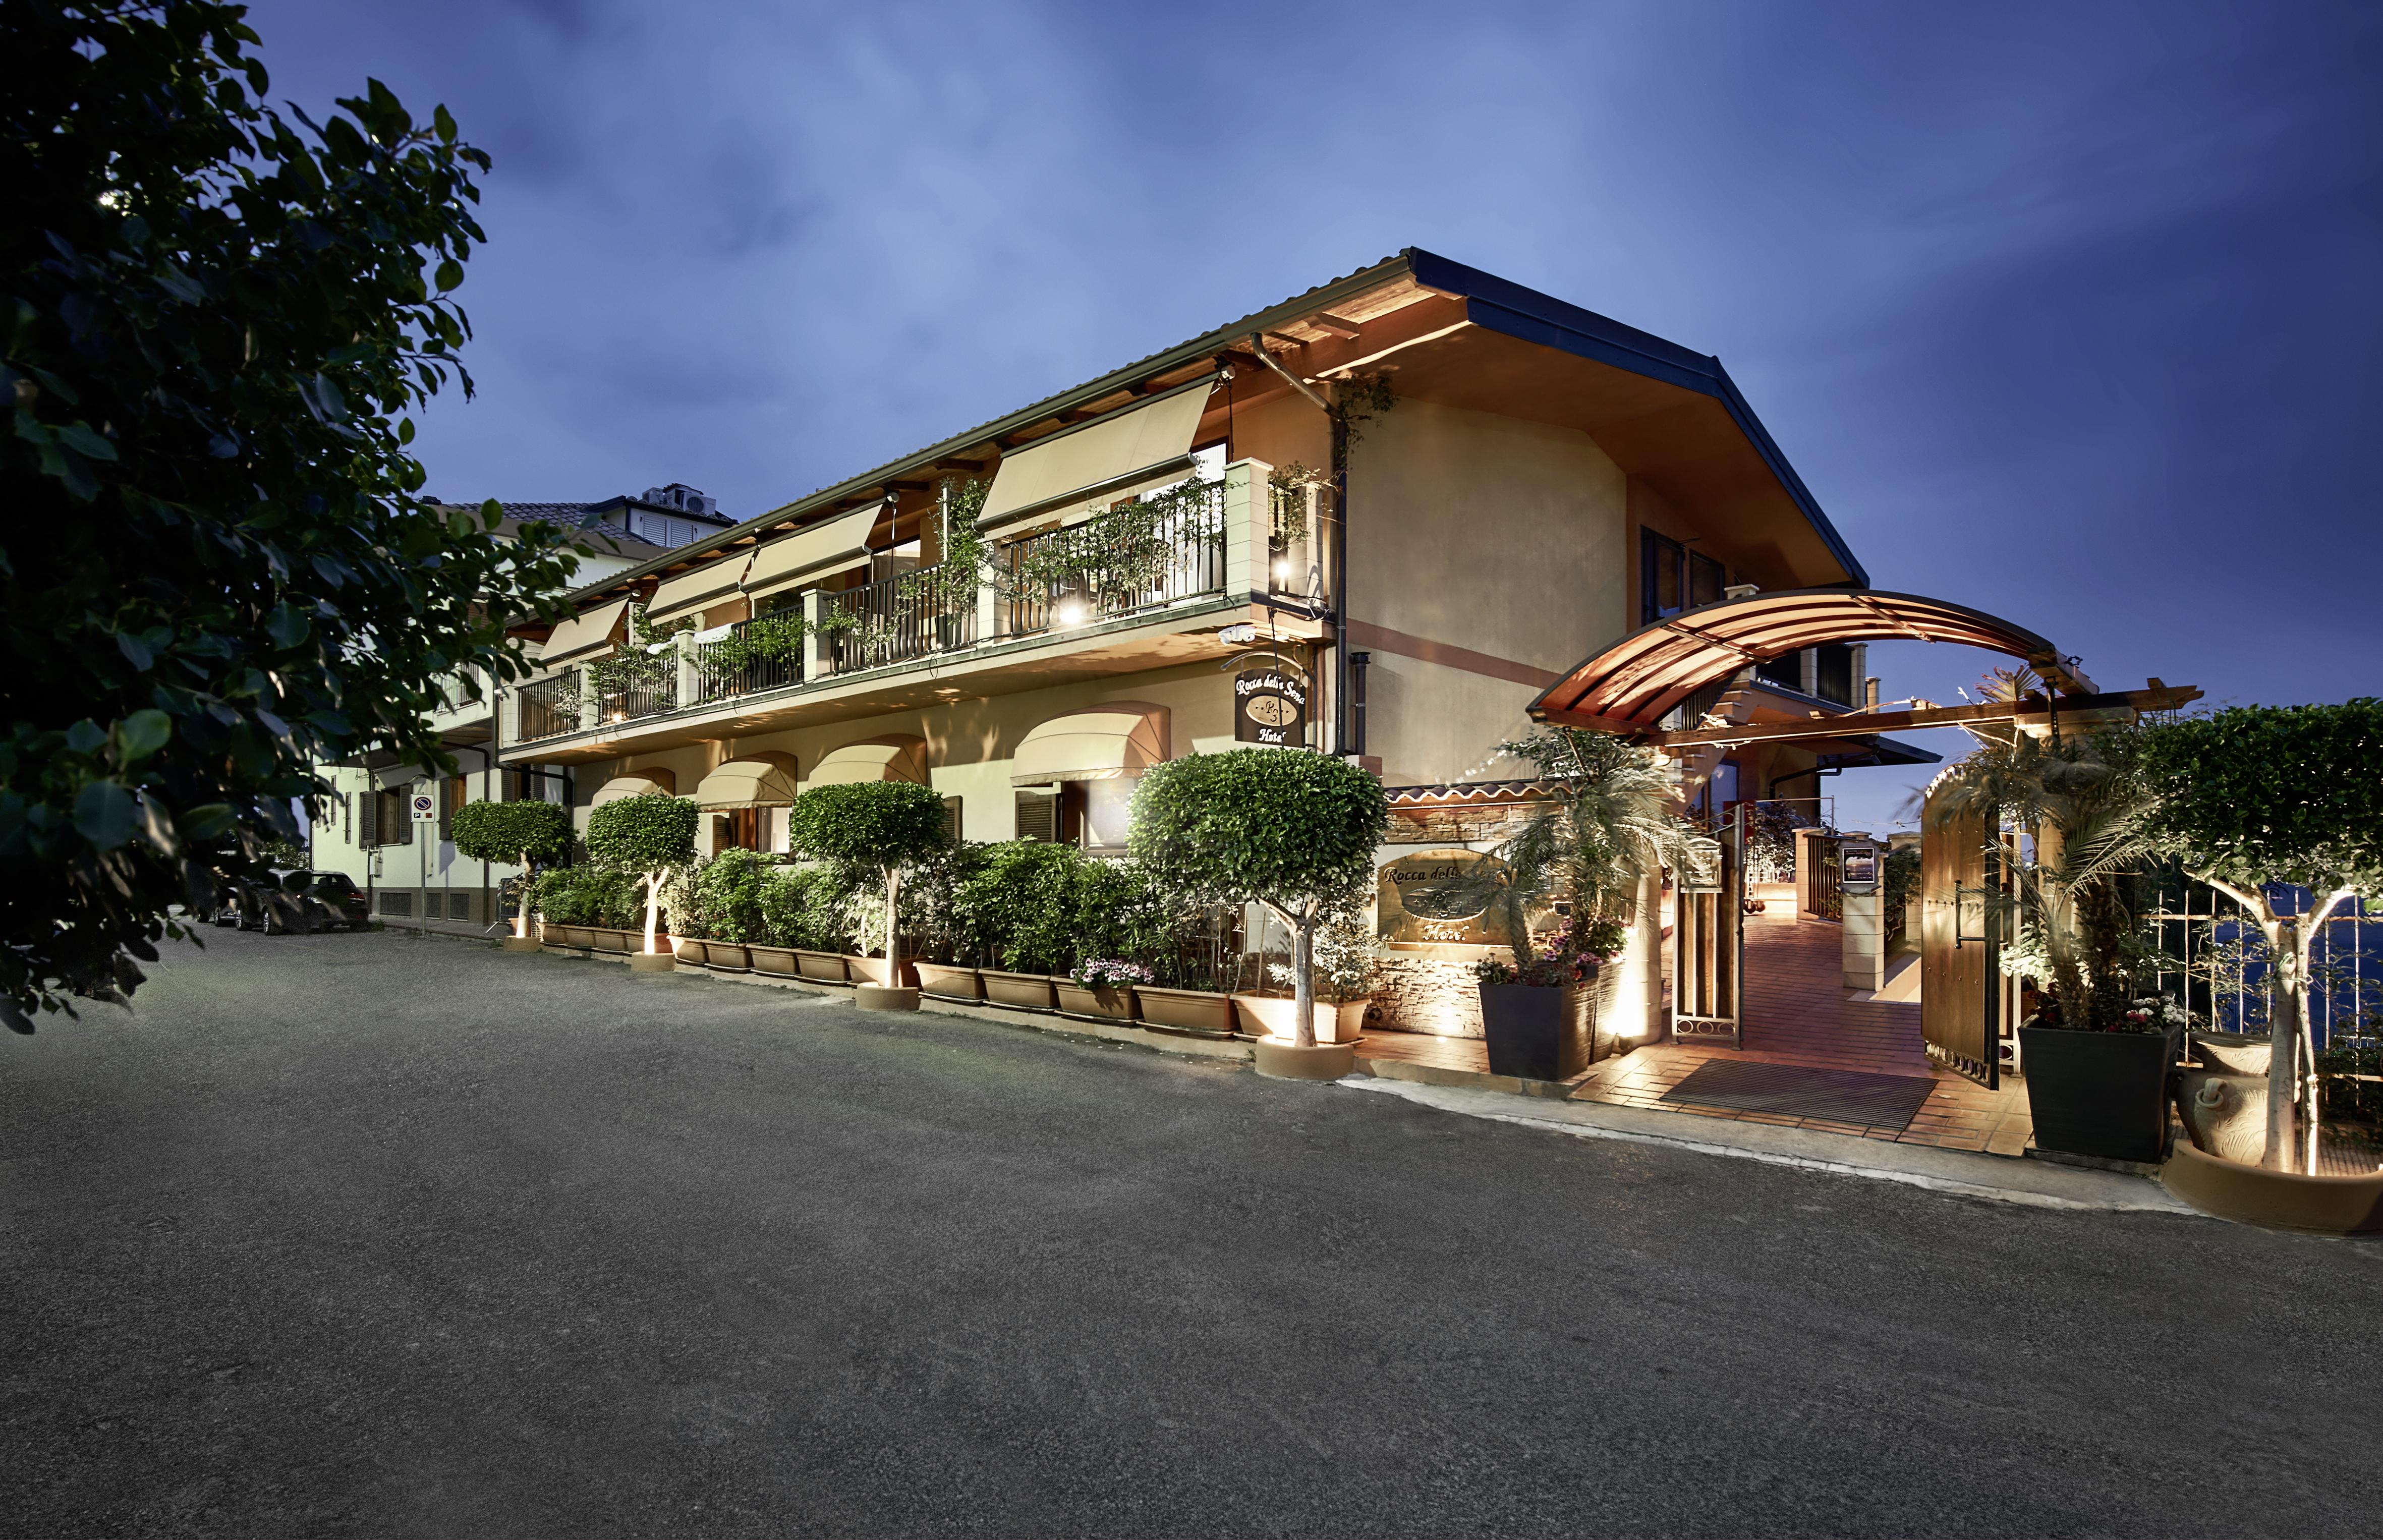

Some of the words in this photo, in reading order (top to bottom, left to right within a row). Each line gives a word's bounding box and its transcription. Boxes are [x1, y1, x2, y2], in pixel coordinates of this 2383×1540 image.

[1236, 678, 1263, 695] Rocca
[1384, 867, 1427, 885] Rocca
[1423, 924, 1470, 941] Hotel
